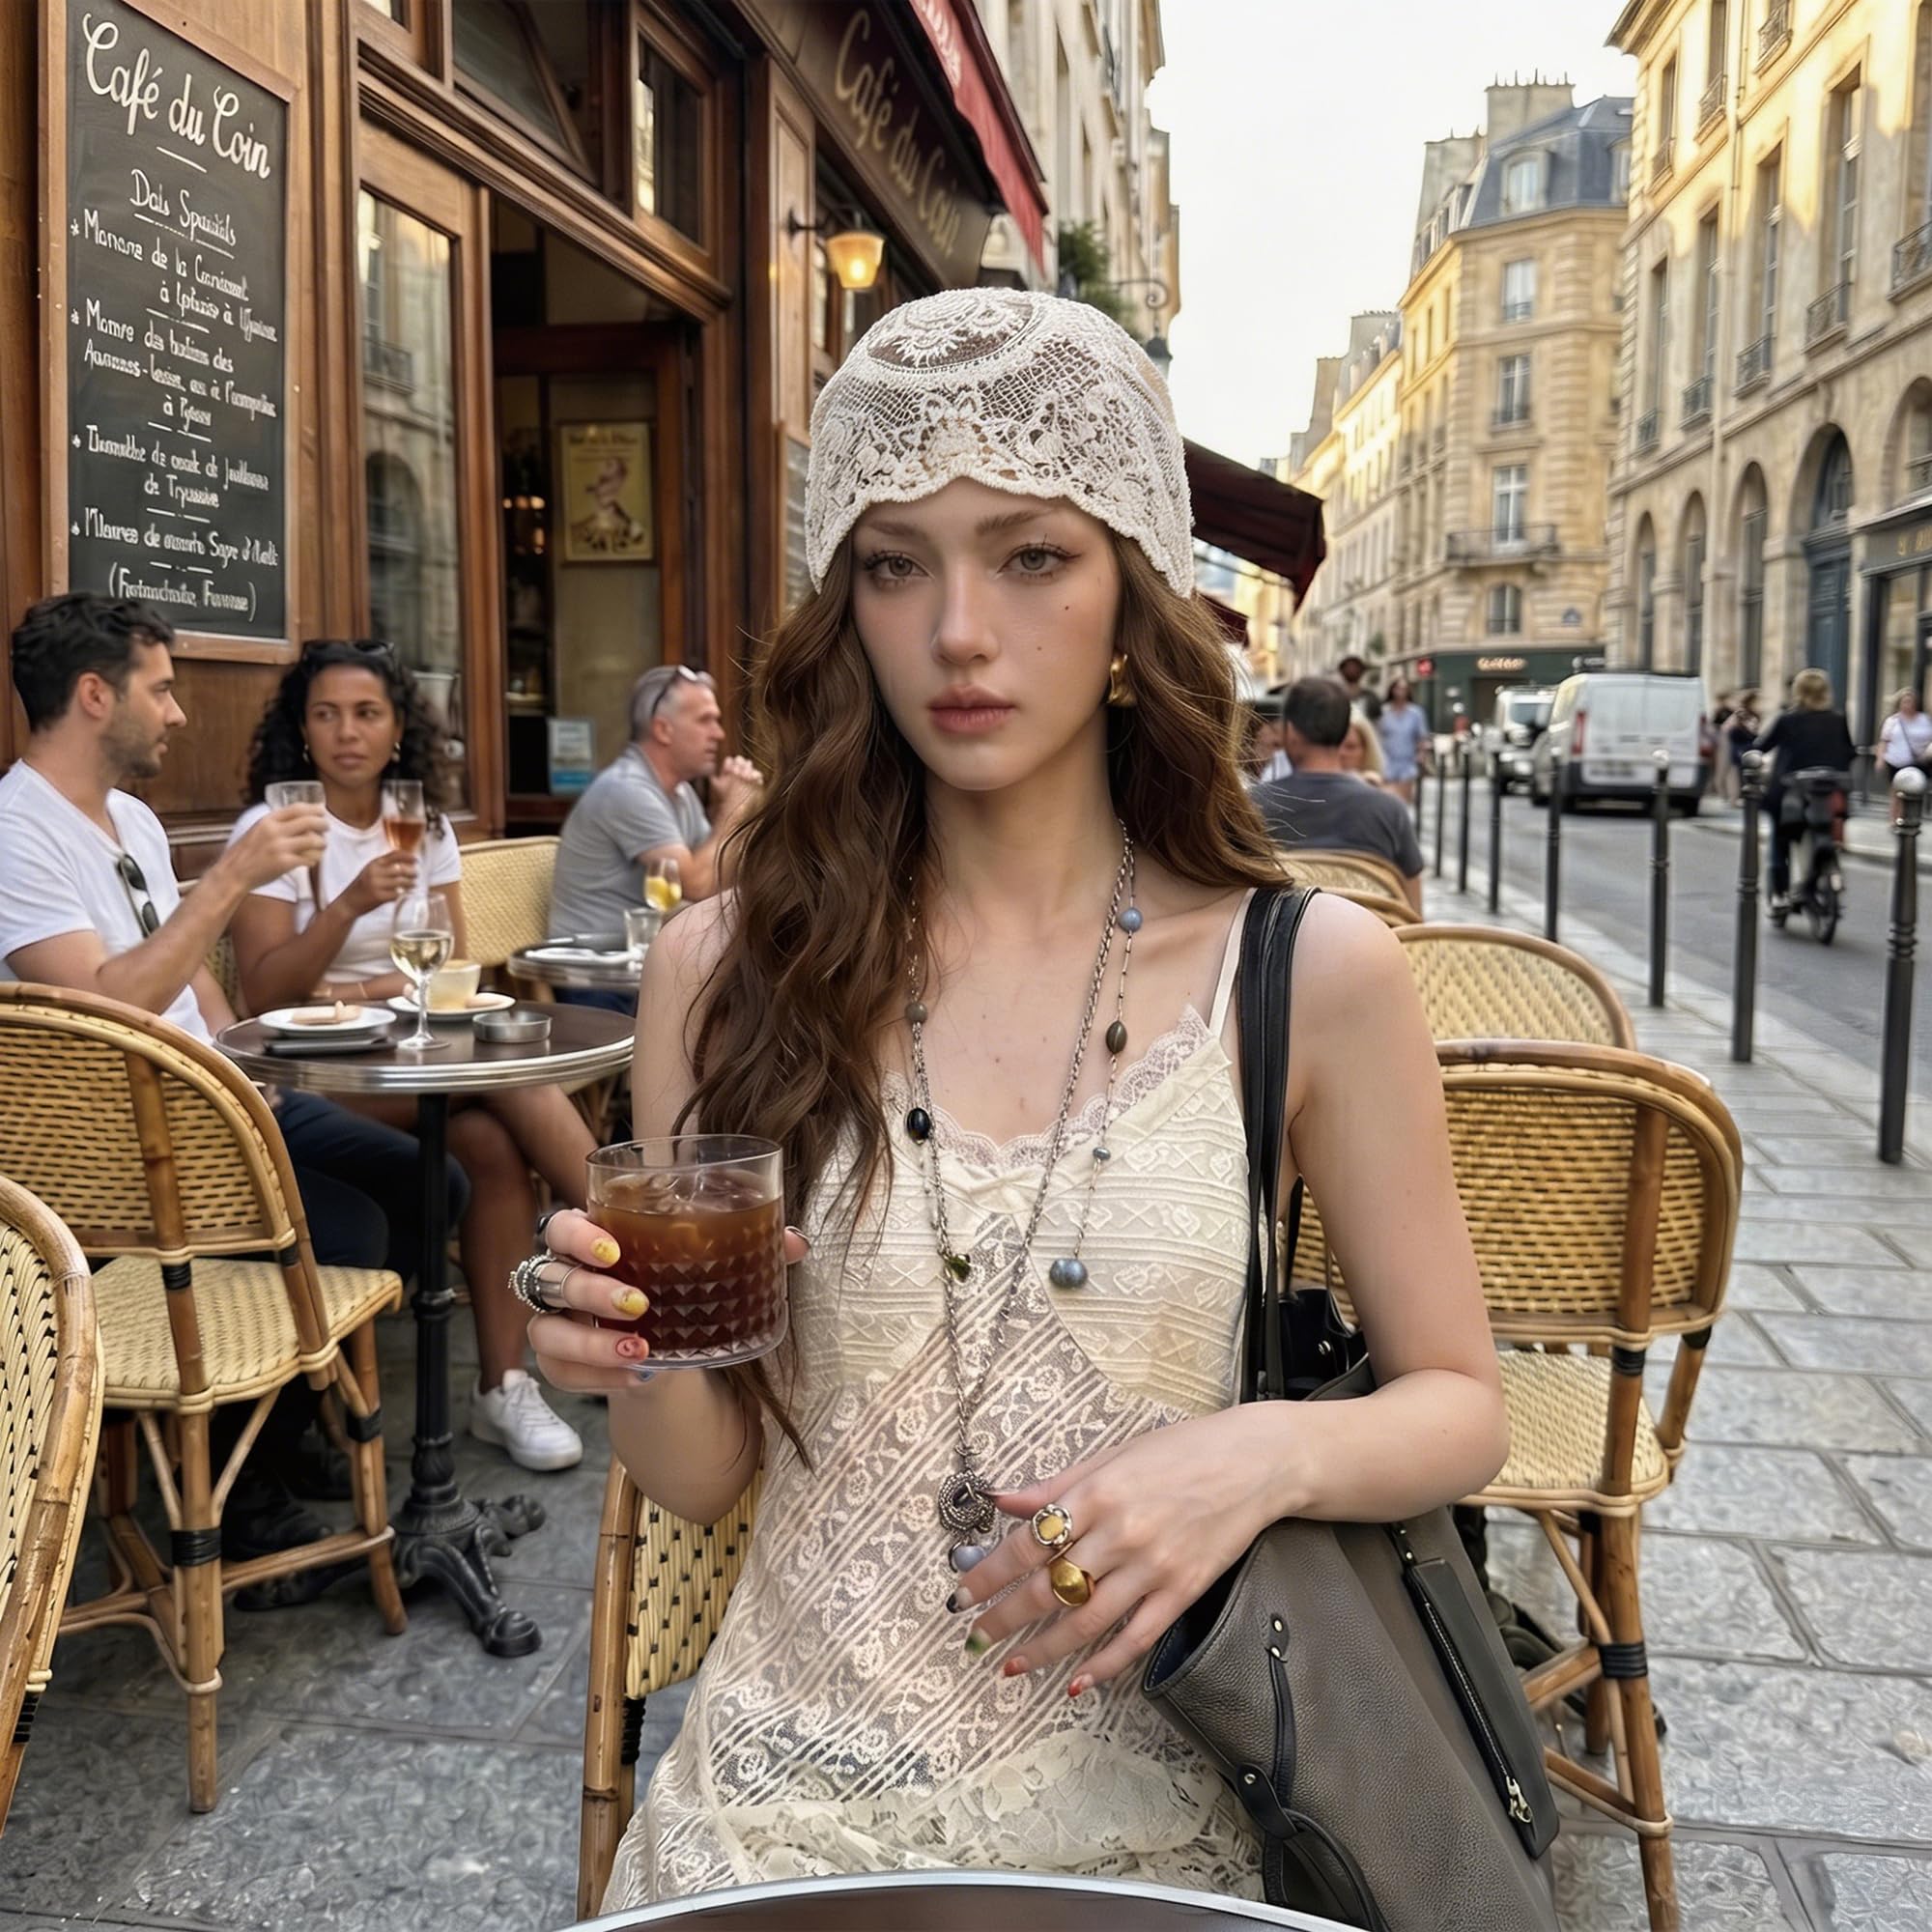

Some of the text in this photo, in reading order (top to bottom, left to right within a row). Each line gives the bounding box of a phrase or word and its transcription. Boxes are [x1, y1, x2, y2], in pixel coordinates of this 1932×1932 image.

[82, 13, 271, 180] Café du Coin
[152, 237, 168, 270] de
